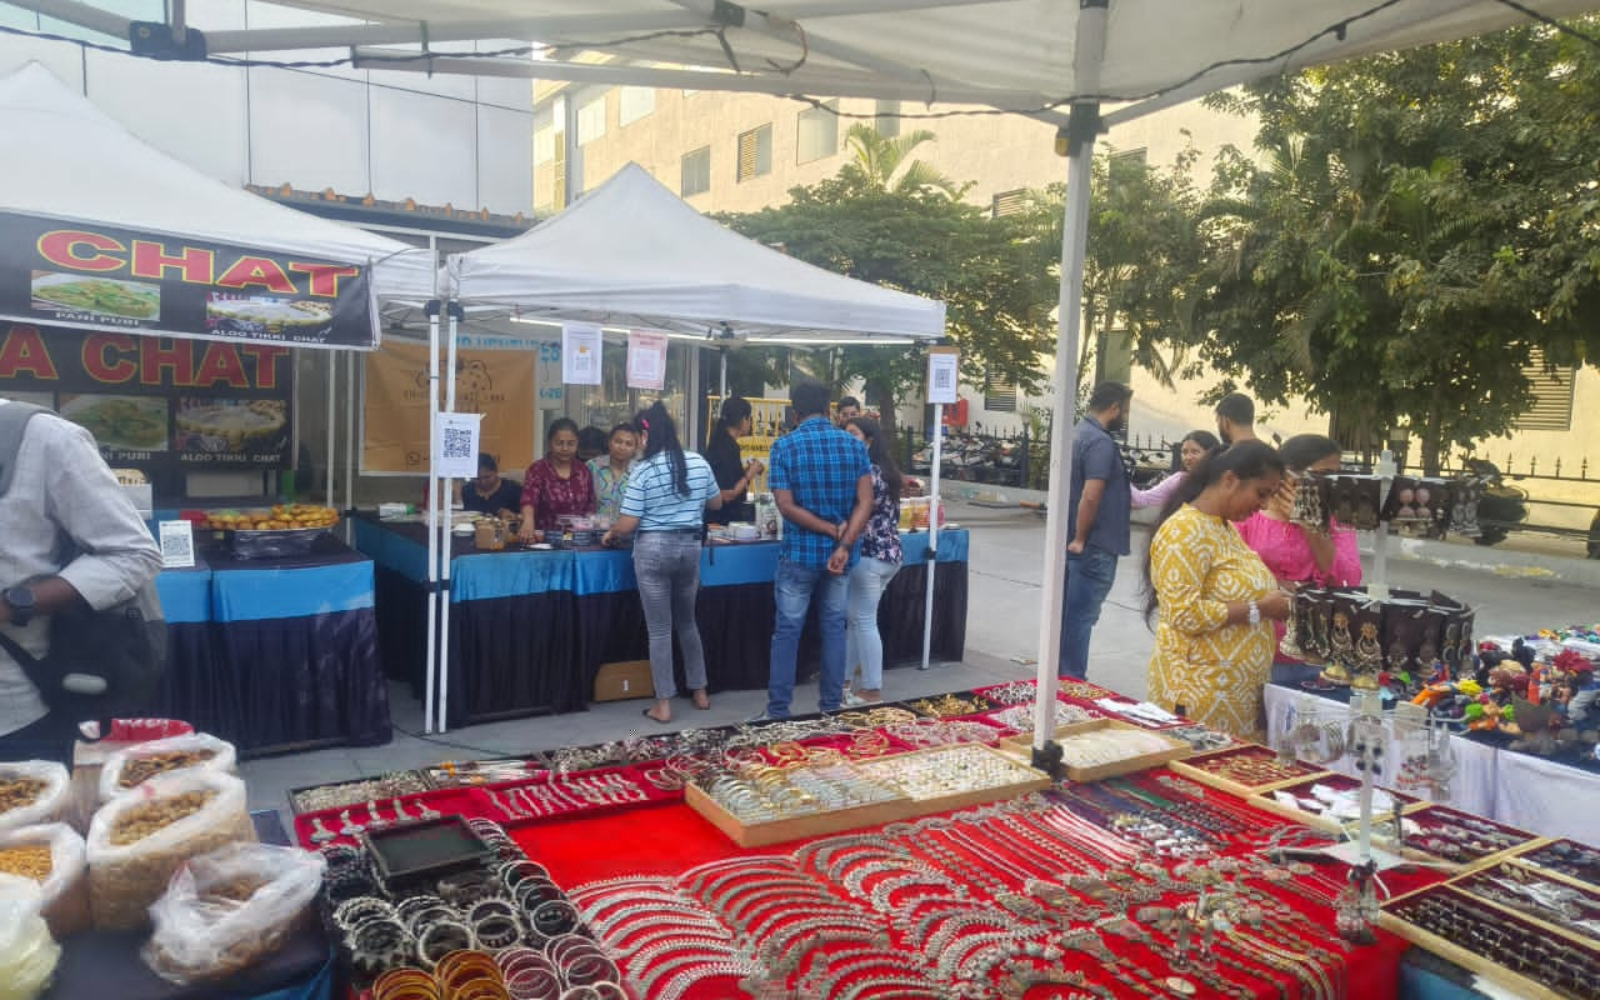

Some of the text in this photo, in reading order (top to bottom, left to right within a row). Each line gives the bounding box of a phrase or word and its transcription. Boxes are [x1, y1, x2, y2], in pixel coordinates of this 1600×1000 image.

[36, 229, 359, 298] CHAT
[55, 311, 139, 326] PANI PURI
[211, 329, 326, 344] ALOO TIKKI CHAT
[81, 332, 290, 389] CHAT
[118, 452, 151, 461] PURI
[180, 453, 281, 462] ALOO TIKKI CHAT
